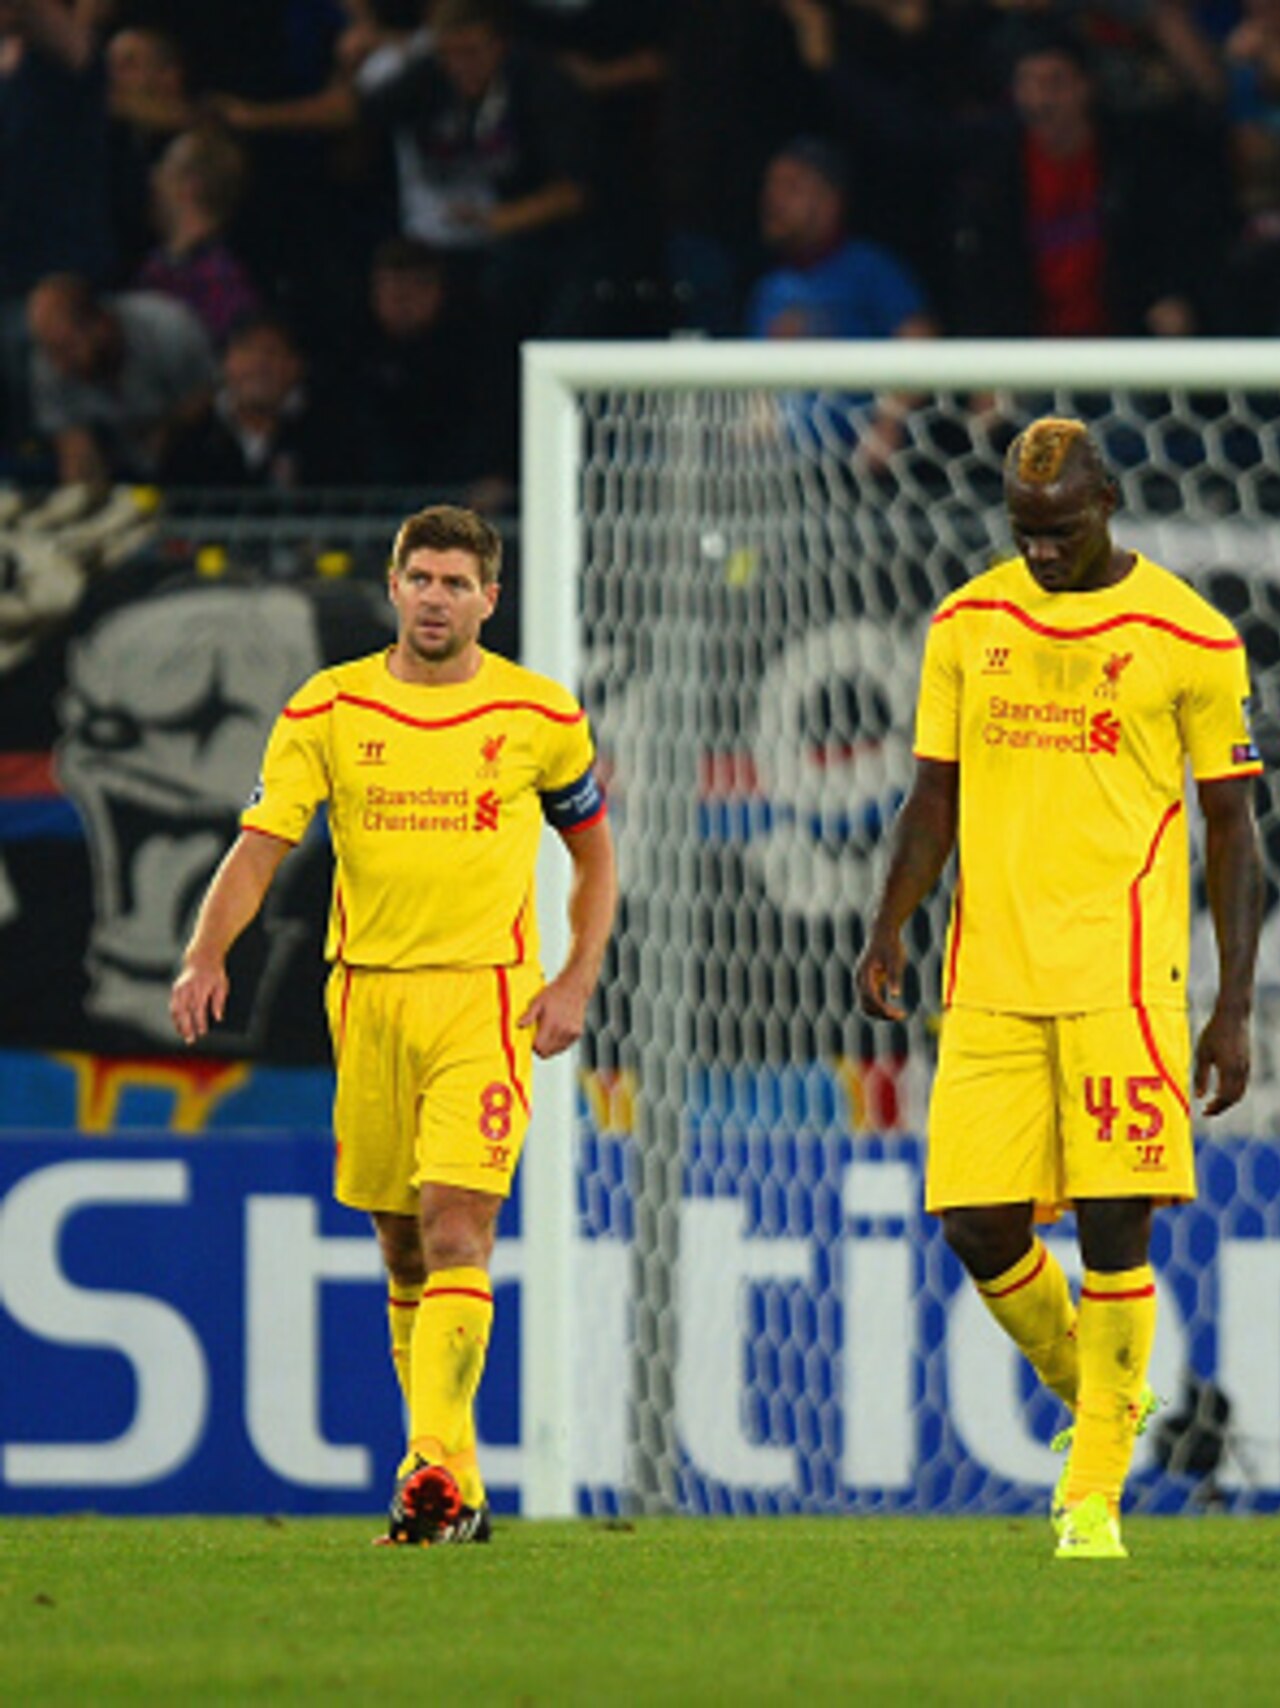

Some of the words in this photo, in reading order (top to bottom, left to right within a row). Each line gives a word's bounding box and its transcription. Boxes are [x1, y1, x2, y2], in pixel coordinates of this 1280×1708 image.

[981, 723, 1086, 753] Charred
[366, 784, 468, 806] Standard
[362, 811, 468, 831] Chartered
[479, 1080, 513, 1141] 8
[1084, 1075, 1163, 1142] 45
